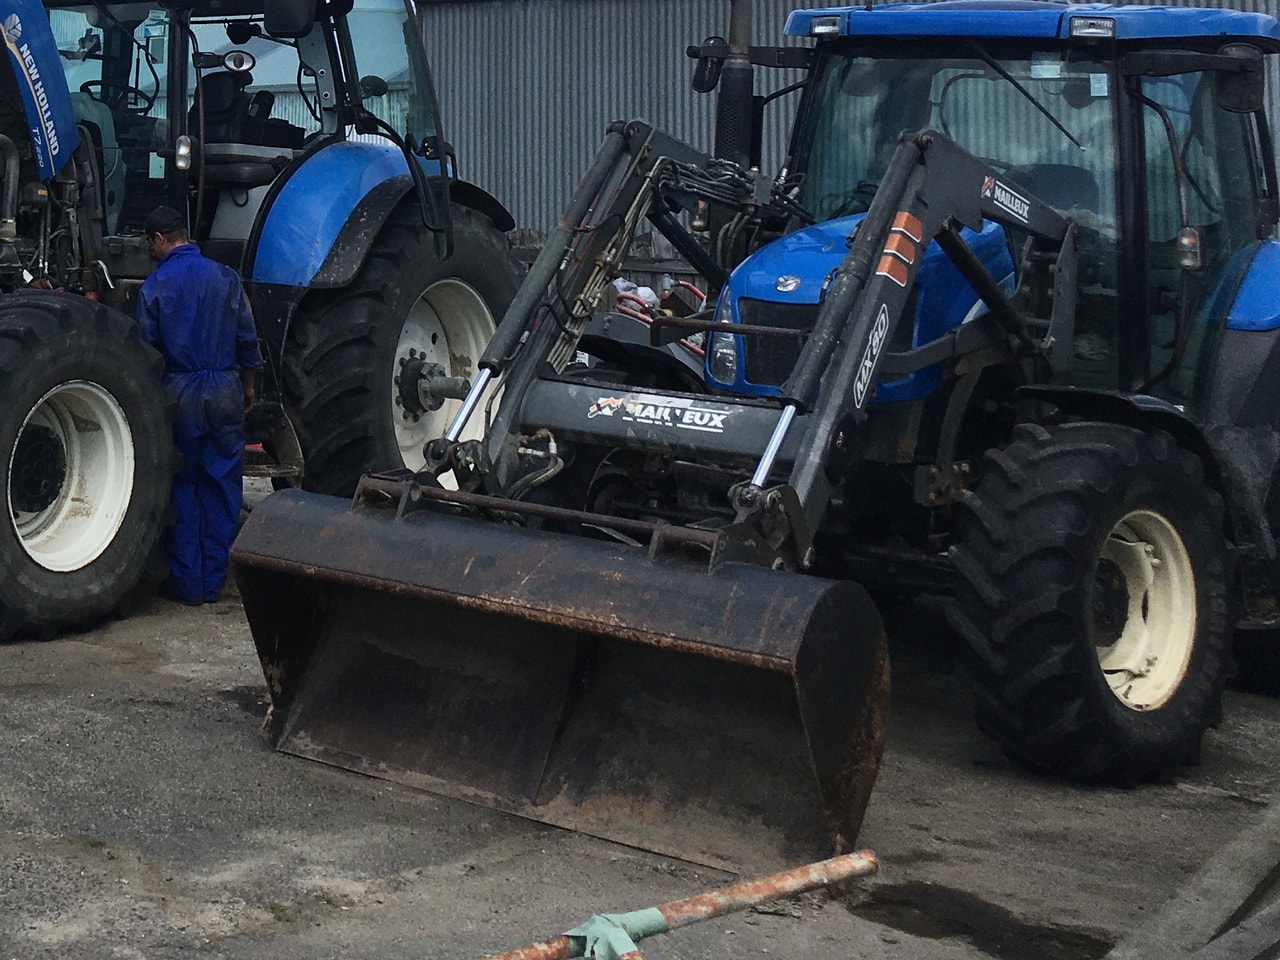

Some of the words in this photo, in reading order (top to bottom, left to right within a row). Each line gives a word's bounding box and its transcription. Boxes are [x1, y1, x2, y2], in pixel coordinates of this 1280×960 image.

[20, 43, 40, 81] NEW
[35, 81, 61, 156] HOLLAND
[994, 185, 1030, 219] MAILLEUX
